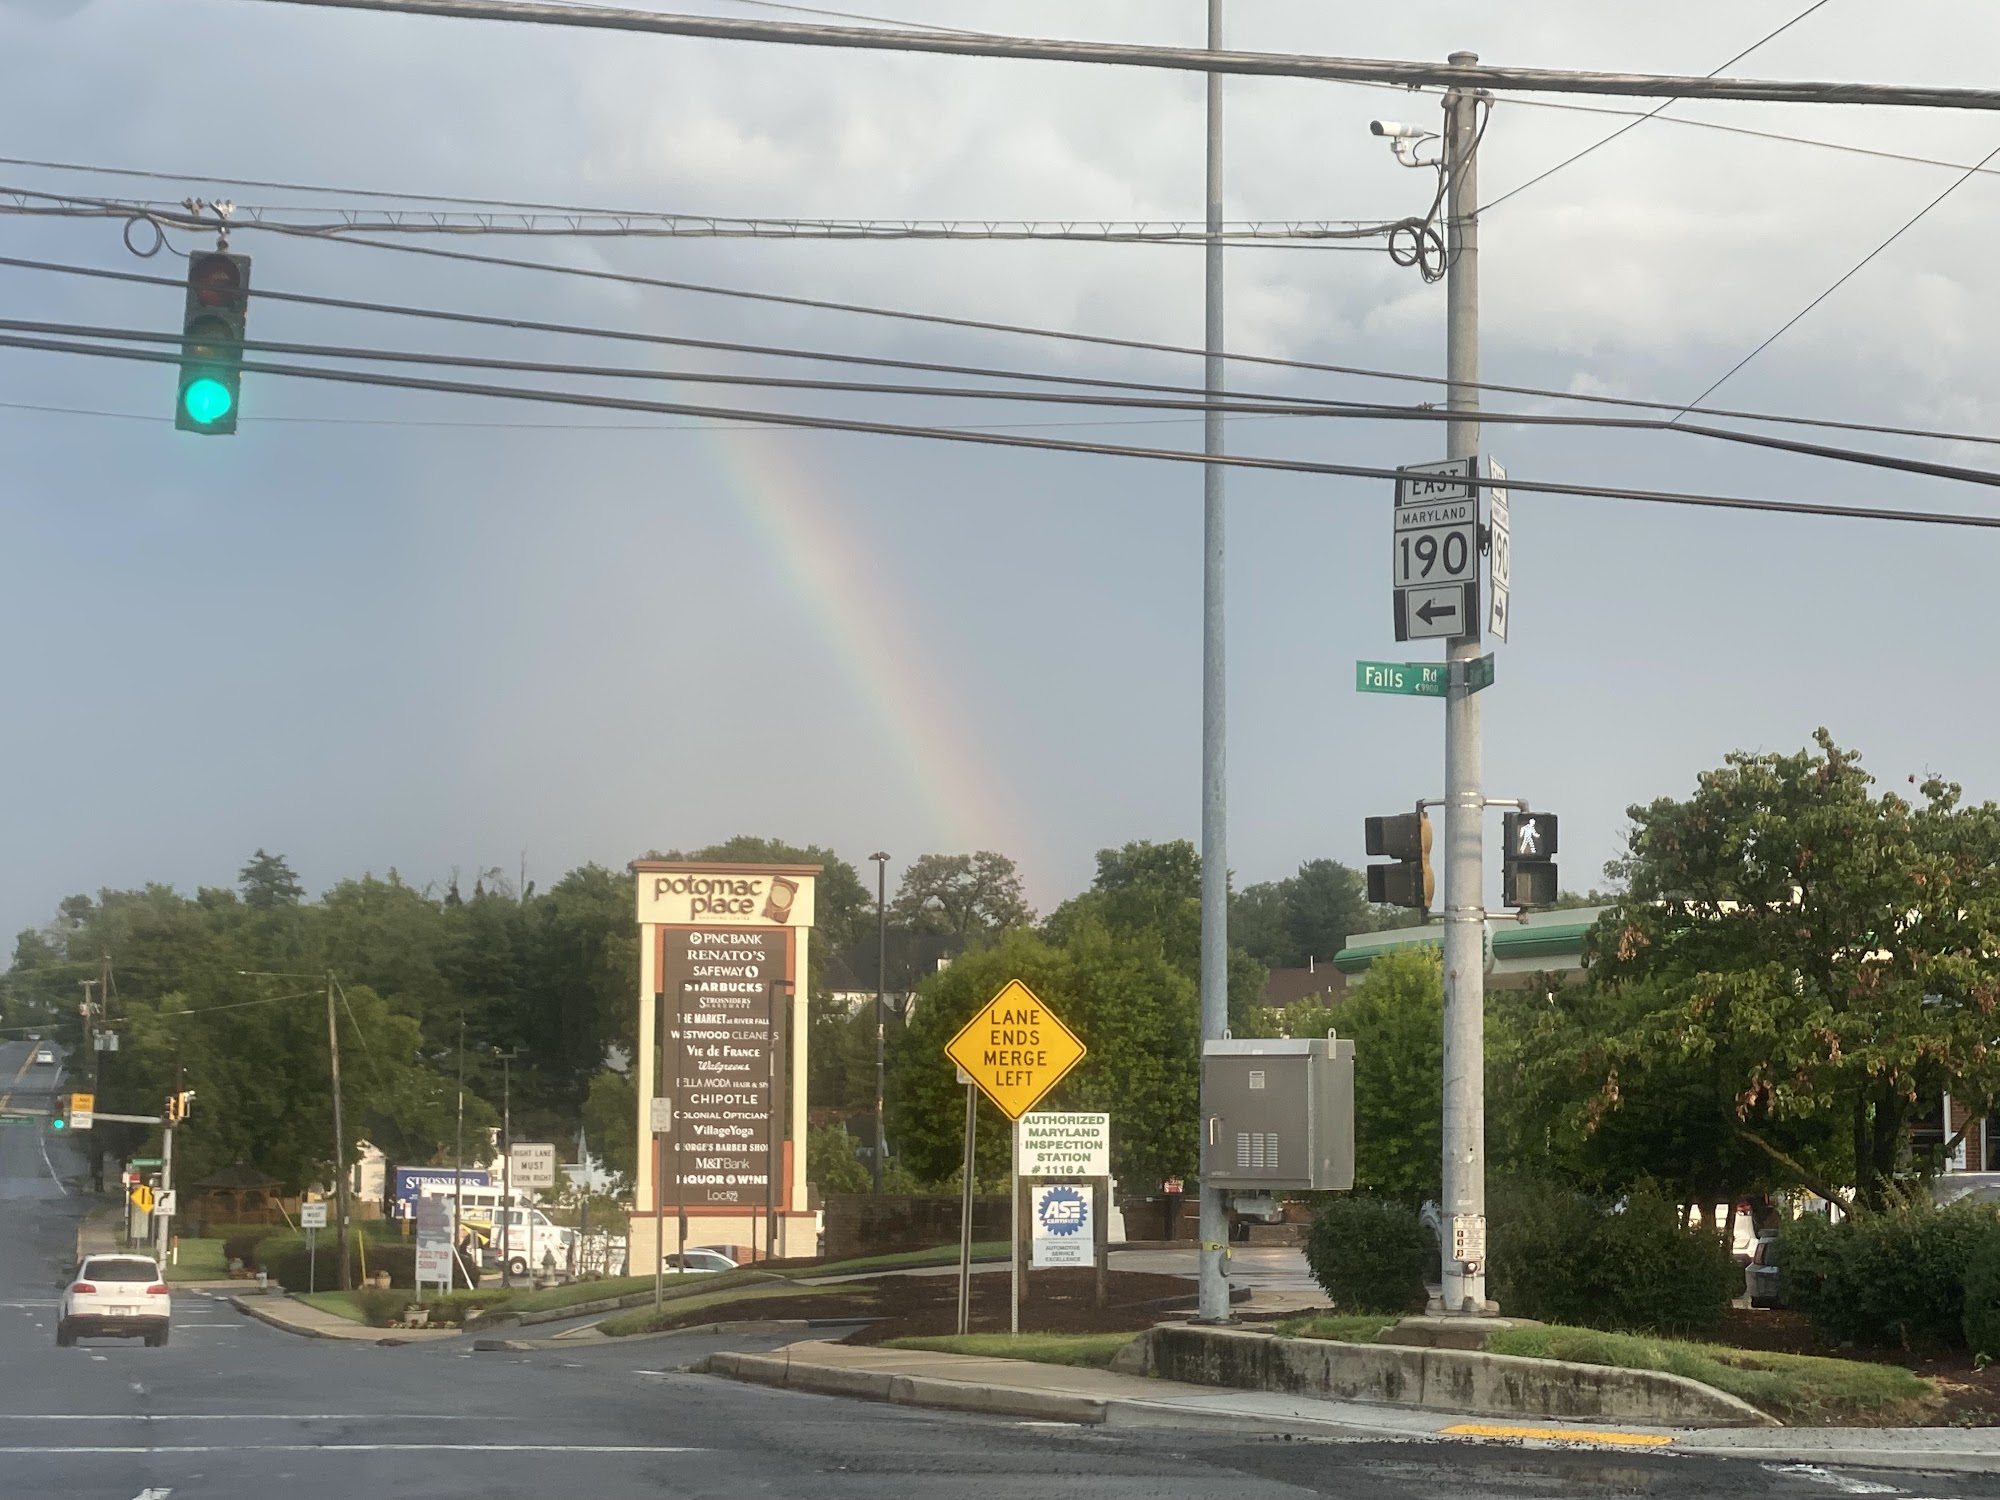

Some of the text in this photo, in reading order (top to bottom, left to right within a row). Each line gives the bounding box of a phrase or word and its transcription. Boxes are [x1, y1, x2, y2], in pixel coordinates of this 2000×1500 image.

[1412, 468, 1459, 496] EAST
[1402, 506, 1466, 525] MARYLAND
[1400, 531, 1468, 580] 190
[1493, 528, 1508, 580] 190
[1365, 666, 1437, 688] Falls Rd
[654, 874, 762, 902] potomac
[690, 893, 755, 921] place
[703, 933, 763, 945] PNC BANK
[687, 949, 766, 962] RENATO'S
[693, 965, 744, 977] SAFEWAY
[694, 1013, 727, 1025] MARKET
[991, 1009, 1040, 1025] LANE
[731, 1031, 780, 1040] CLEANES
[991, 1029, 1040, 1046] ENDS
[984, 1050, 1048, 1067] MERGE
[697, 1060, 751, 1074] Walgreens
[704, 1078, 731, 1088] MODA
[996, 1070, 1033, 1087] LEFT
[690, 1093, 759, 1105] CHIPOTLE
[722, 1111, 769, 1120] OPTICIAN
[1022, 1115, 1106, 1125] AUTHORIZED
[1028, 1128, 1100, 1137] MARYLAND
[674, 1142, 714, 1152] GORGE'S
[715, 1143, 748, 1152] BARBER
[1025, 1140, 1103, 1150] INSPECTION
[513, 1149, 552, 1157] RIGHT LANE
[1037, 1152, 1091, 1162] STATION
[520, 1161, 544, 1170] MUST
[695, 1157, 750, 1170] M&T Bank
[1030, 1165, 1086, 1175] # 1116 A
[405, 1176, 481, 1189] STROSNIERS
[512, 1174, 552, 1182] TURN RIGHT
[1043, 1200, 1081, 1219] ASE
